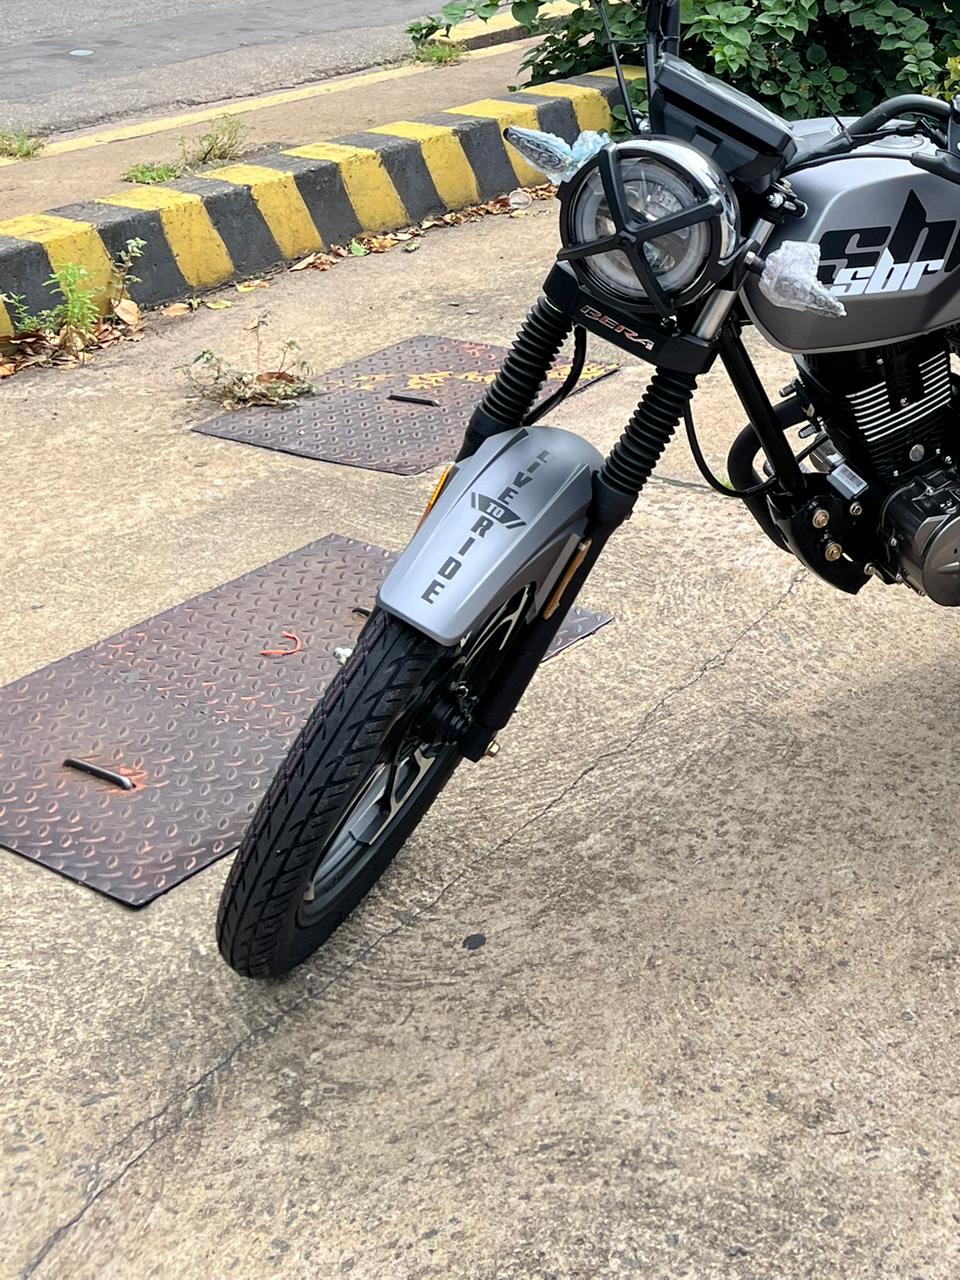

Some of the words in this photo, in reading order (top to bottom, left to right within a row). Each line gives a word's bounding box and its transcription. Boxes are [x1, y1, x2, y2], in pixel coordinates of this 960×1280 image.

[829, 246, 945, 296] sbr
[580, 305, 655, 351] BERA
[497, 449, 550, 506] LIVE
[485, 502, 505, 518] TO
[420, 515, 494, 605] RIDE
